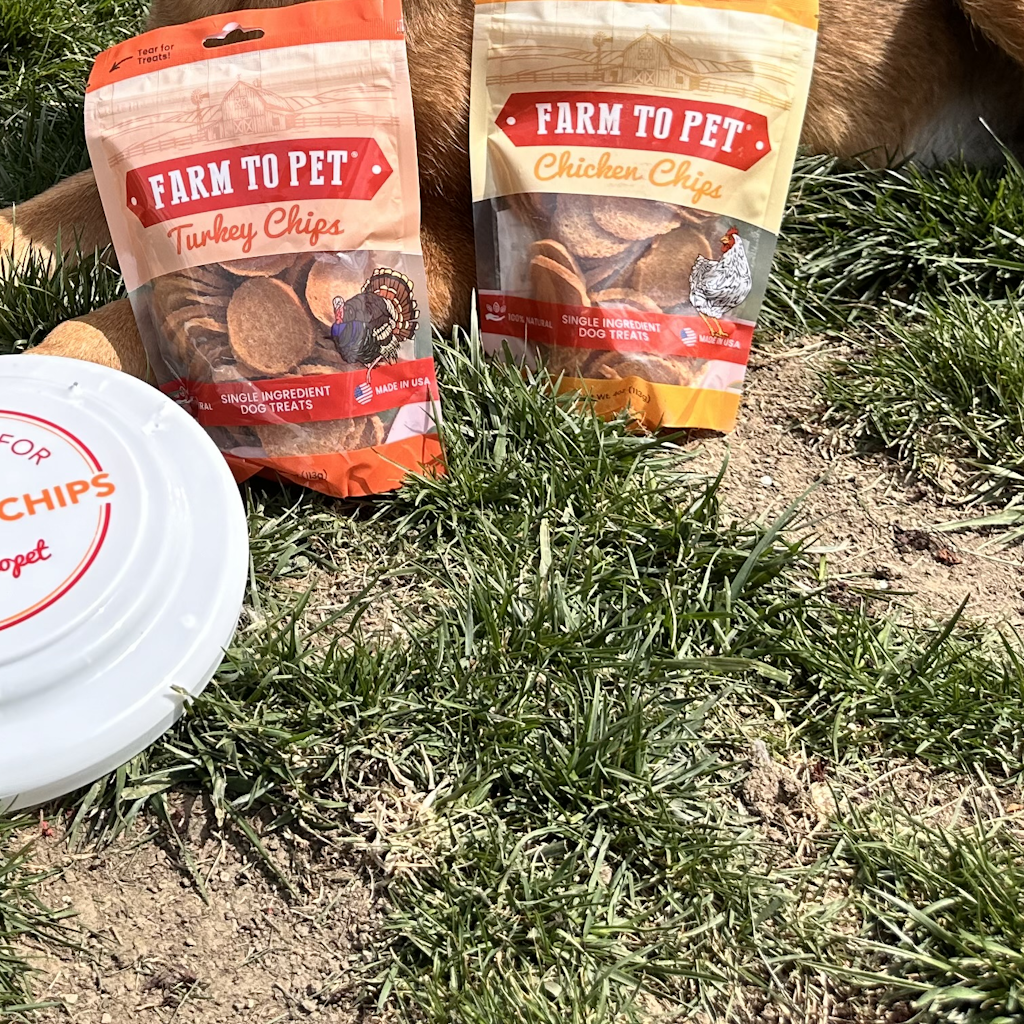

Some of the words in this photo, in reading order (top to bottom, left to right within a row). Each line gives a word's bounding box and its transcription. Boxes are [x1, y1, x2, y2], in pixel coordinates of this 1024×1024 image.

[137, 46, 158, 56] Tear
[161, 44, 174, 52] for
[137, 52, 171, 64] Treats!
[535, 102, 623, 136] FARM
[633, 104, 673, 140] TO
[148, 159, 234, 210] FARM
[241, 156, 279, 190] TO
[534, 152, 643, 182] Chicken
[648, 158, 722, 204] Chips
[167, 213, 257, 255] Turkey
[264, 204, 344, 246] Chips
[507, 312, 525, 323] 100%
[525, 316, 553, 329] NATURAL
[562, 314, 599, 327] SINGLE
[602, 318, 661, 332] INGREDIENT
[578, 328, 606, 339] DOG
[609, 329, 650, 341] TREATS
[698, 334, 716, 344] MADE
[723, 338, 741, 349] USA
[220, 392, 258, 404] SINGLE
[261, 385, 331, 401] INGREDIENT
[375, 381, 398, 395] MADE
[399, 380, 409, 389] IN
[411, 376, 431, 387] USA
[240, 403, 267, 415] DOG
[269, 399, 314, 412] TREATS
